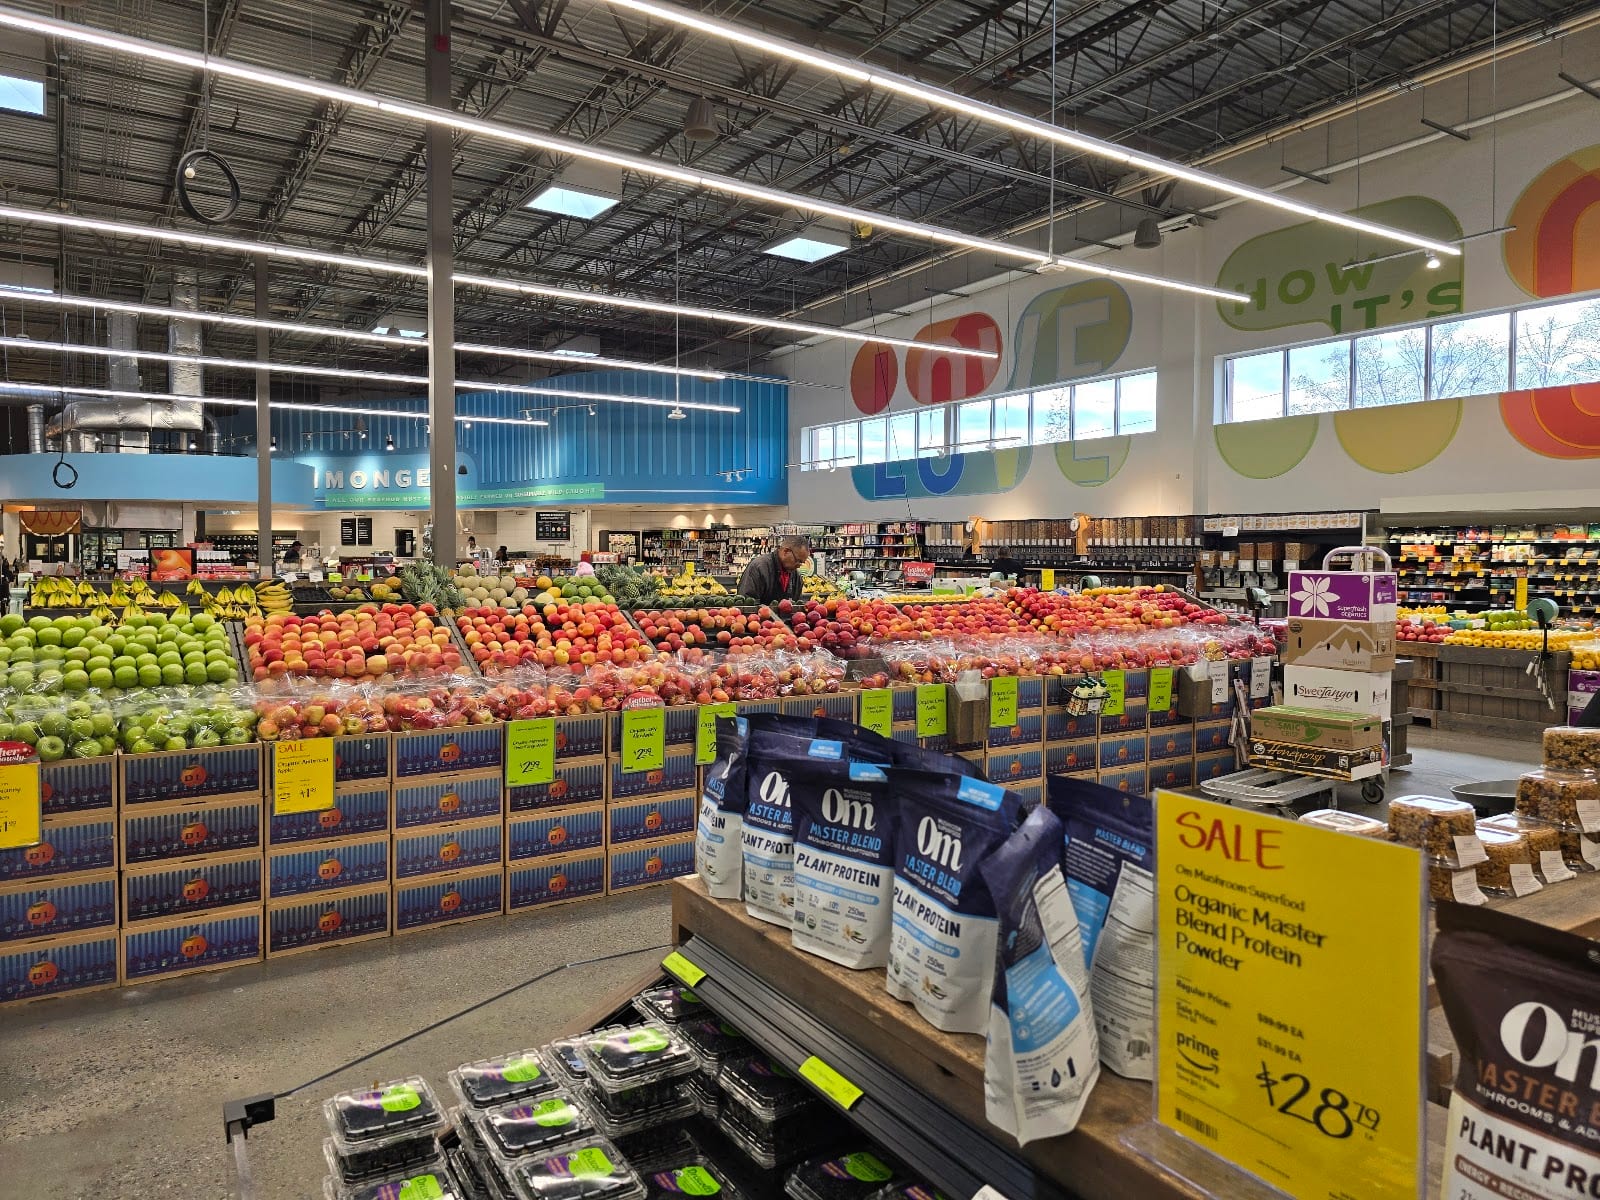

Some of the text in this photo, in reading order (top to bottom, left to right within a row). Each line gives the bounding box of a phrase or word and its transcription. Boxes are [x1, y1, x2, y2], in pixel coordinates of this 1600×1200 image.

[1234, 252, 1379, 316] HOW
[1331, 281, 1461, 335] IT'S
[314, 468, 431, 490] MONGE
[0, 752, 27, 763] ously
[278, 743, 305, 754] SALE
[1267, 744, 1327, 766] Honeycrisp
[749, 801, 781, 822] ASTER
[821, 788, 877, 831] Om
[764, 838, 794, 855] PROT
[810, 822, 849, 844] MASTER
[851, 832, 882, 851] BLEND
[917, 816, 963, 872] Om
[1175, 810, 1286, 871] SALE
[796, 852, 834, 876] PLANT
[833, 864, 881, 888] PROTEIN
[1176, 863, 1306, 913] Om Mushroom Superfood
[917, 900, 961, 939] PROTEIN
[1174, 884, 1328, 949] Organic Master
[1176, 907, 1303, 969] Blend Protein
[1176, 931, 1244, 972] Powder
[1175, 979, 1206, 999] Regular
[1176, 1031, 1220, 1061] prime
[1290, 1025, 1305, 1040] EA
[1288, 1048, 1303, 1064] EA
[1558, 1117, 1571, 1130] &
[1459, 1115, 1537, 1172] PLANT
[1542, 1154, 1600, 1200] PRO
